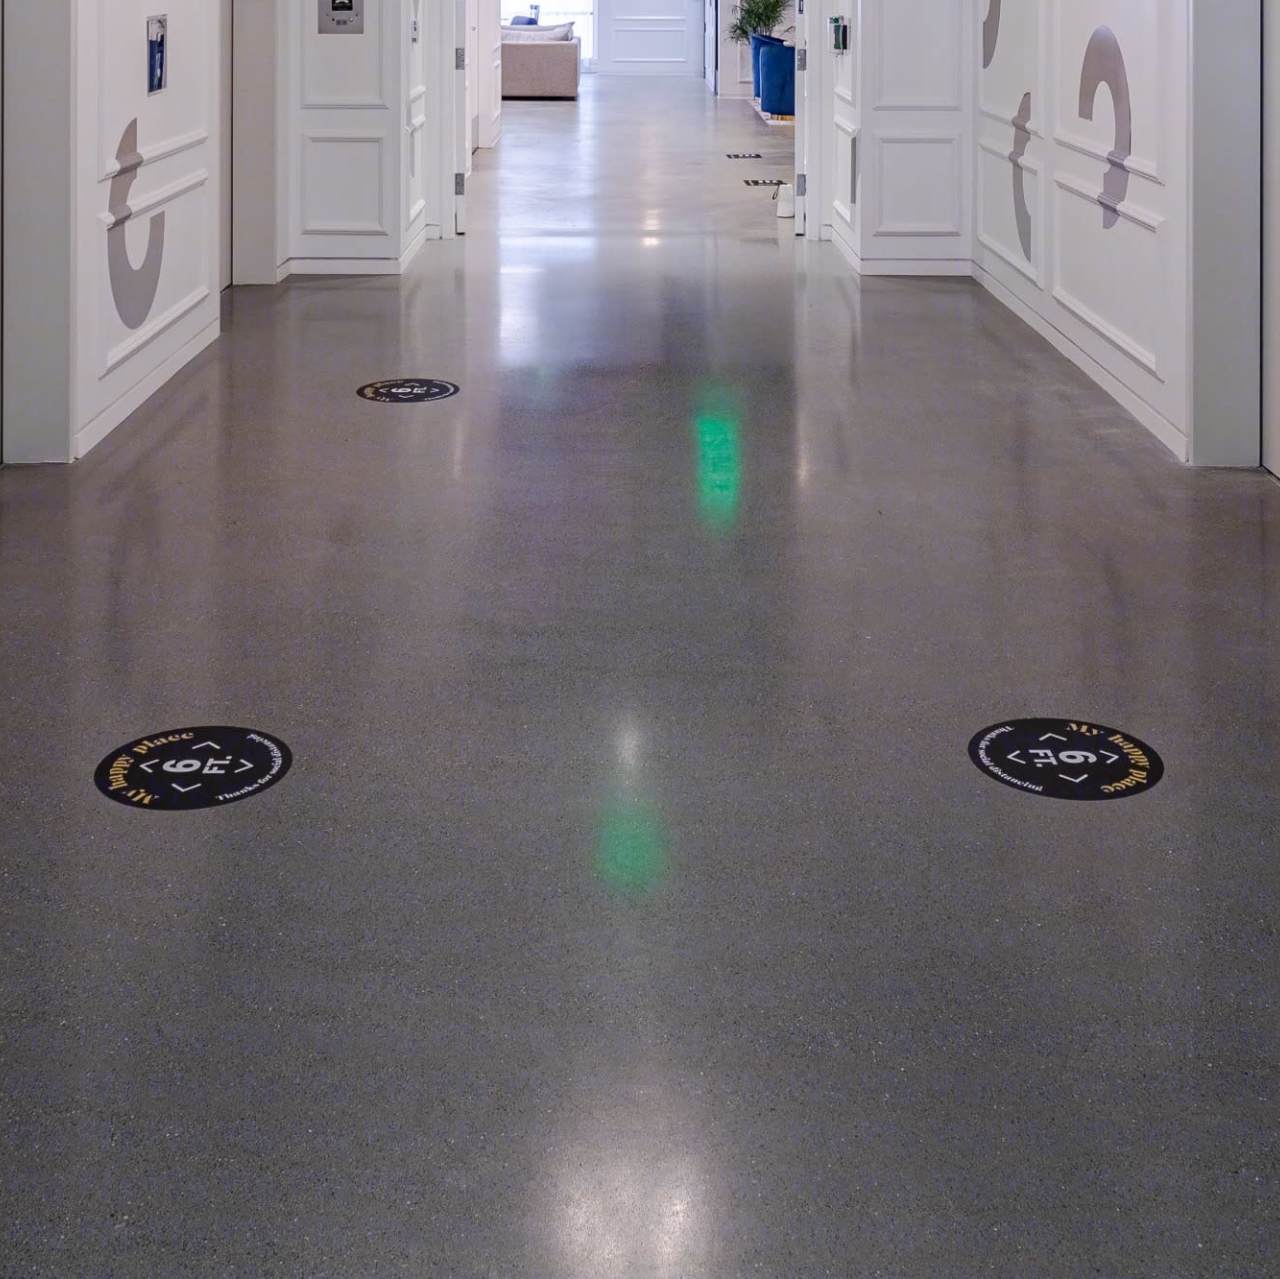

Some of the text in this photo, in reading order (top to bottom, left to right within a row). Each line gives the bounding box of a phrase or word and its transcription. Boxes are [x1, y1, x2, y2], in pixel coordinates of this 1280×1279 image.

[162, 758, 201, 773] 6
[201, 755, 233, 774] FT.
[1028, 749, 1058, 767] FT.
[1058, 750, 1096, 764] 6
[1066, 722, 1149, 794] My happy place
[107, 731, 194, 805] My happy place
[215, 782, 260, 801] Thanks
